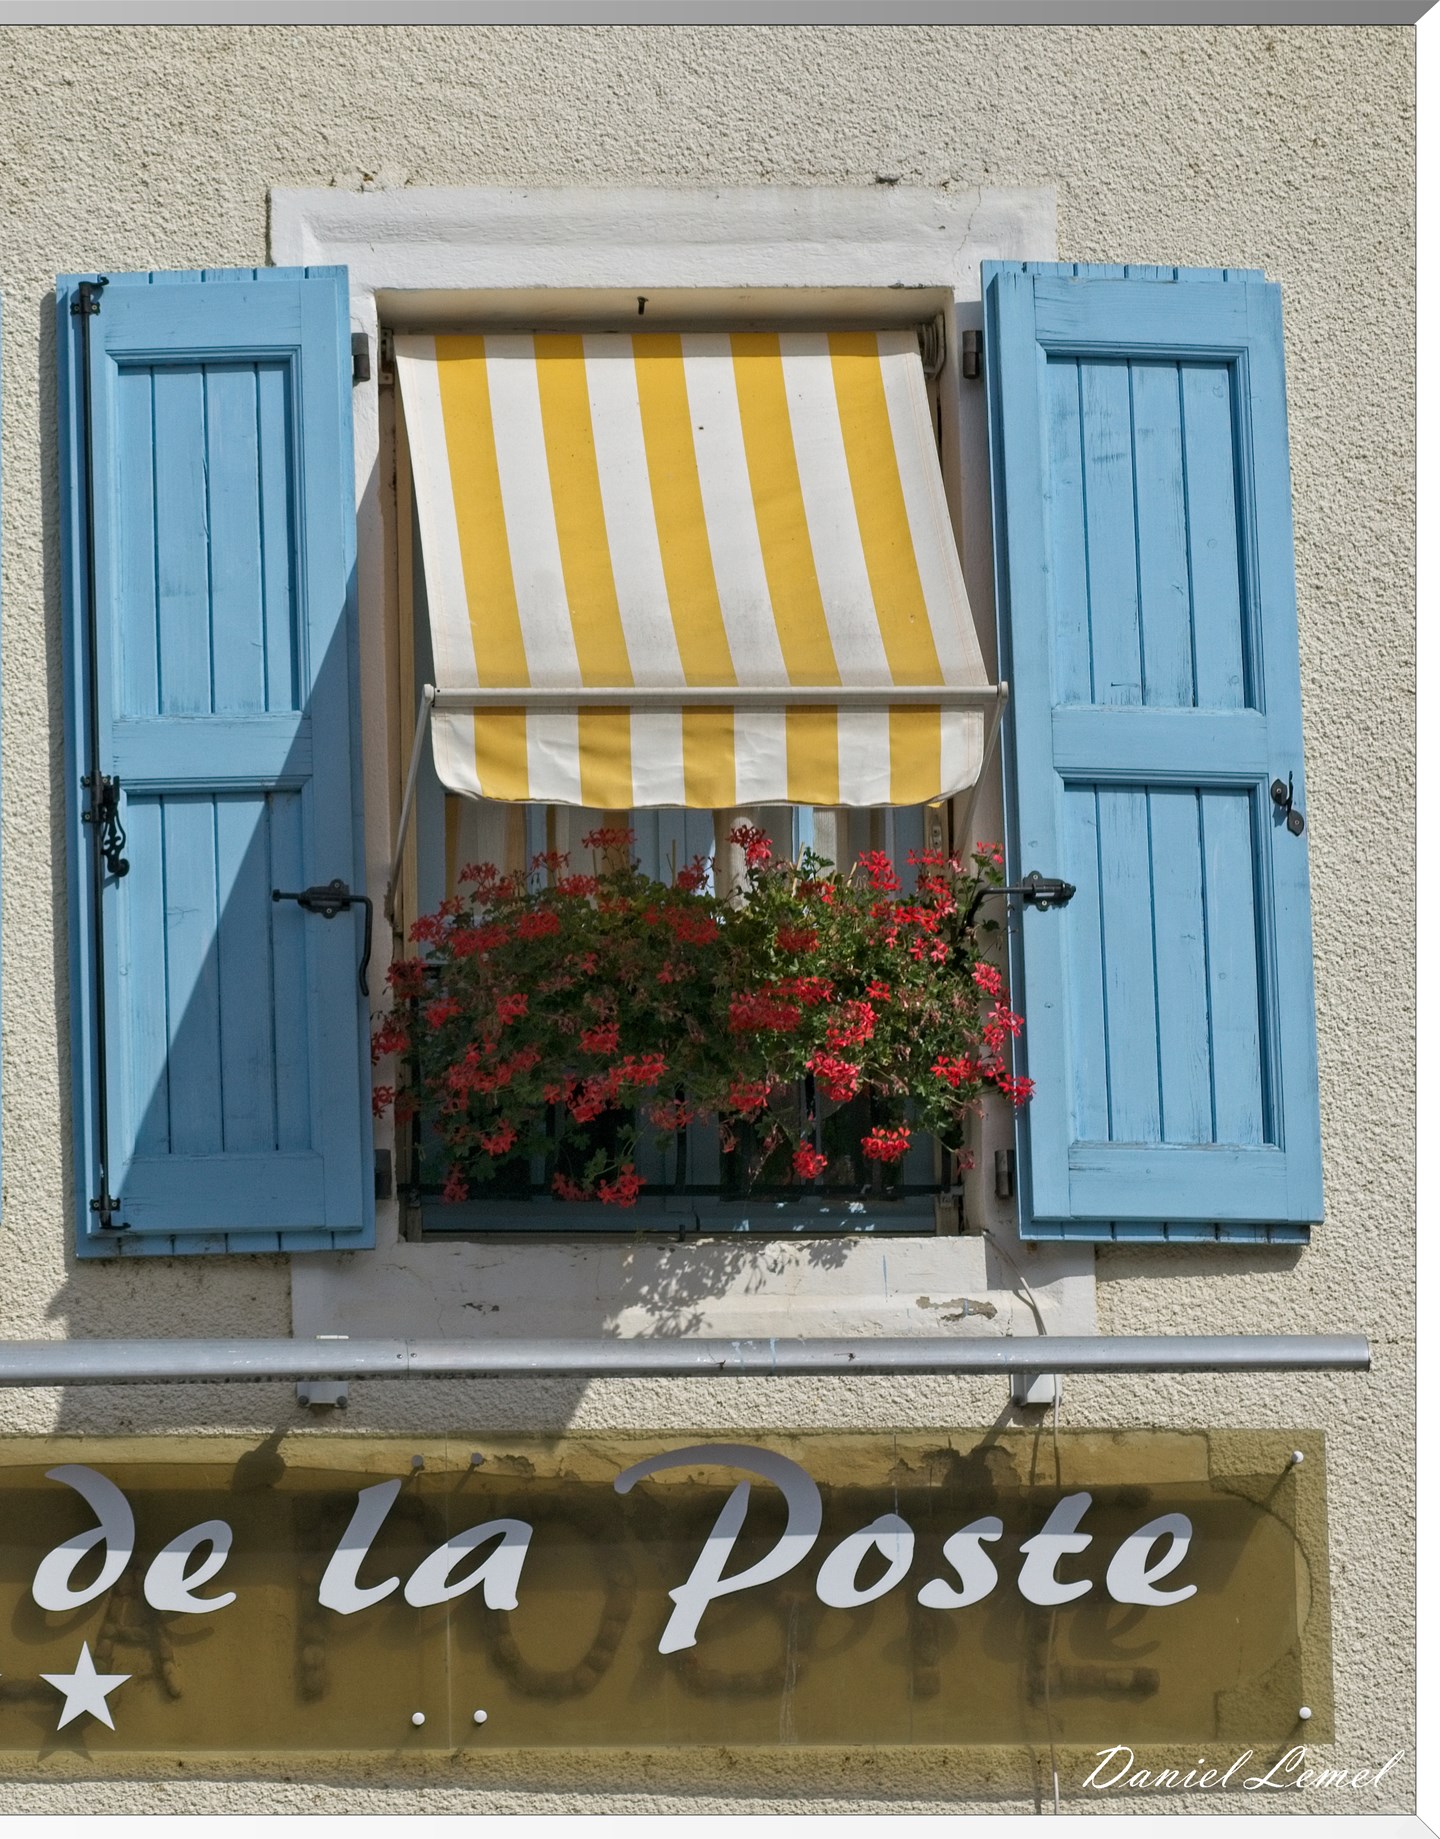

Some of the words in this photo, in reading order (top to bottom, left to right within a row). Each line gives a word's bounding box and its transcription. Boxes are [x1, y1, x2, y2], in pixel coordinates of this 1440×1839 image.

[32, 1464, 236, 1613] de
[318, 1479, 533, 1614] la
[614, 1443, 1197, 1654] Poste
